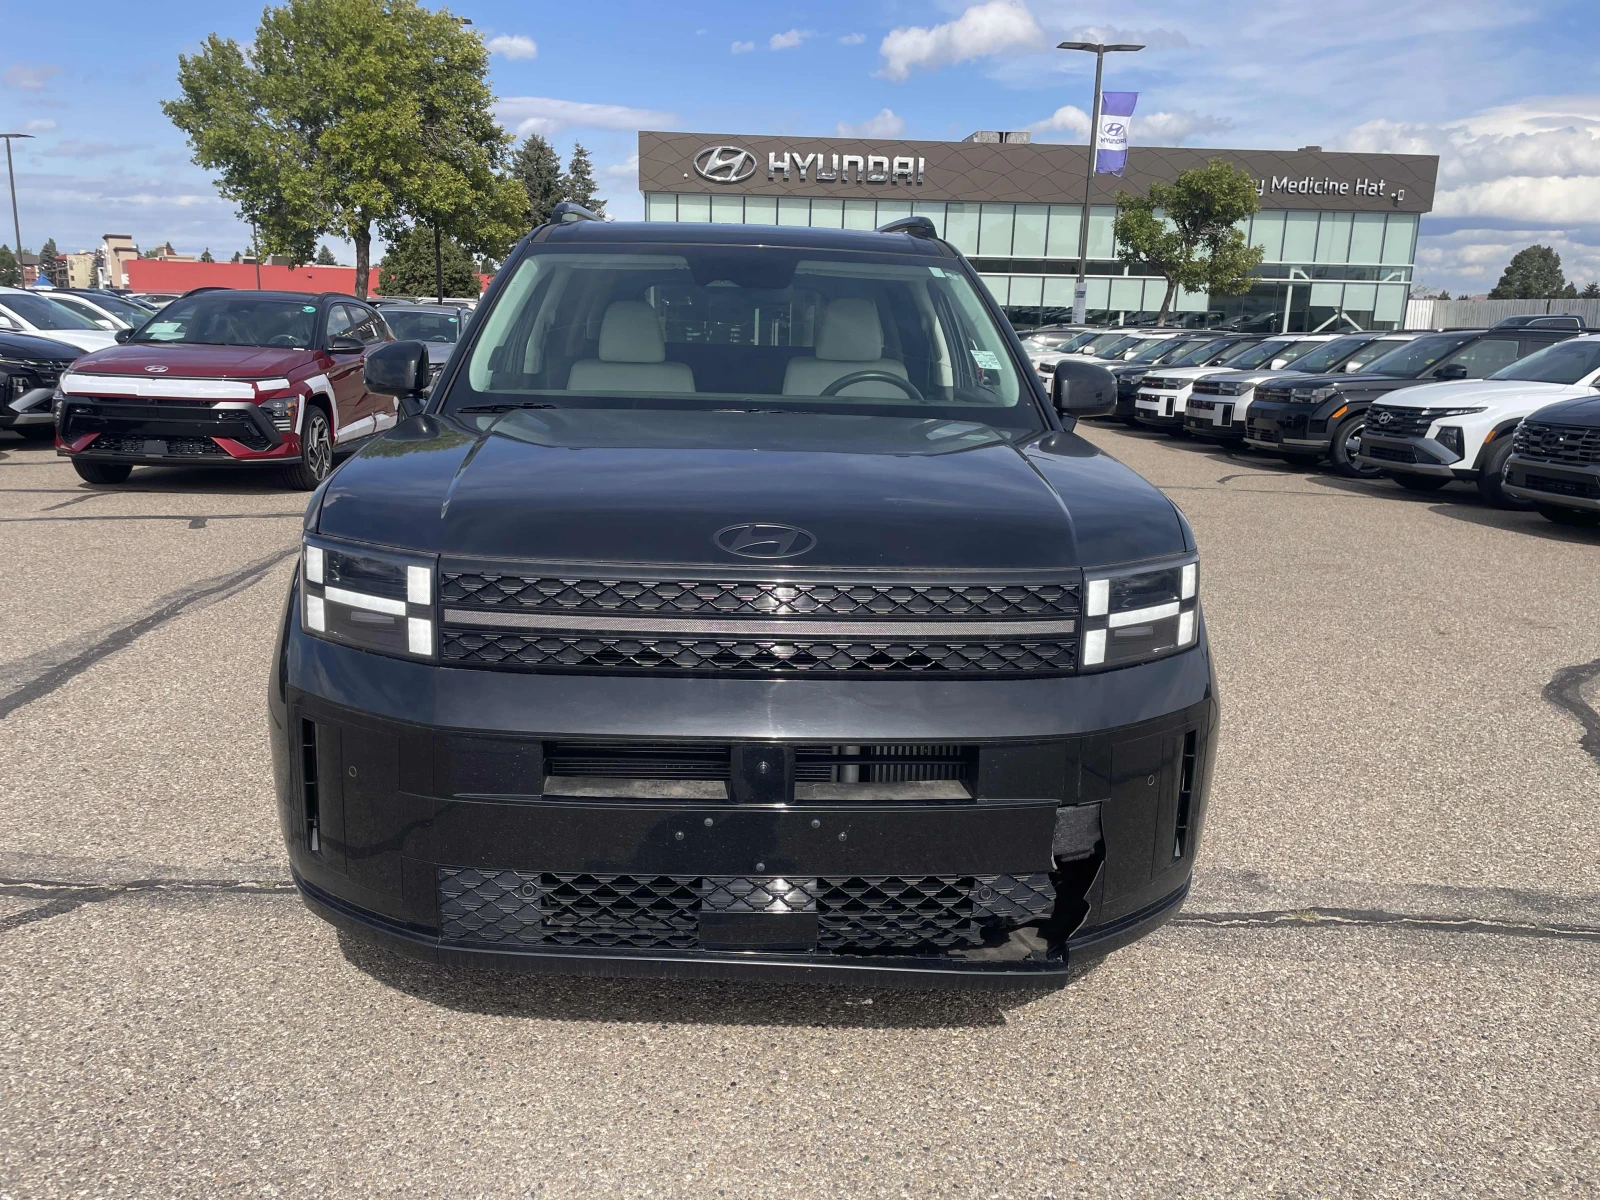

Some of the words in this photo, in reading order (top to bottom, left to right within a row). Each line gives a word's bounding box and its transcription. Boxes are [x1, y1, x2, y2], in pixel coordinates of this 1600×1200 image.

[1100, 137, 1127, 145] HYUNDAI
[768, 152, 925, 185] HYUNDAI
[1270, 175, 1350, 195] Medicine
[1354, 178, 1386, 196] Hat
